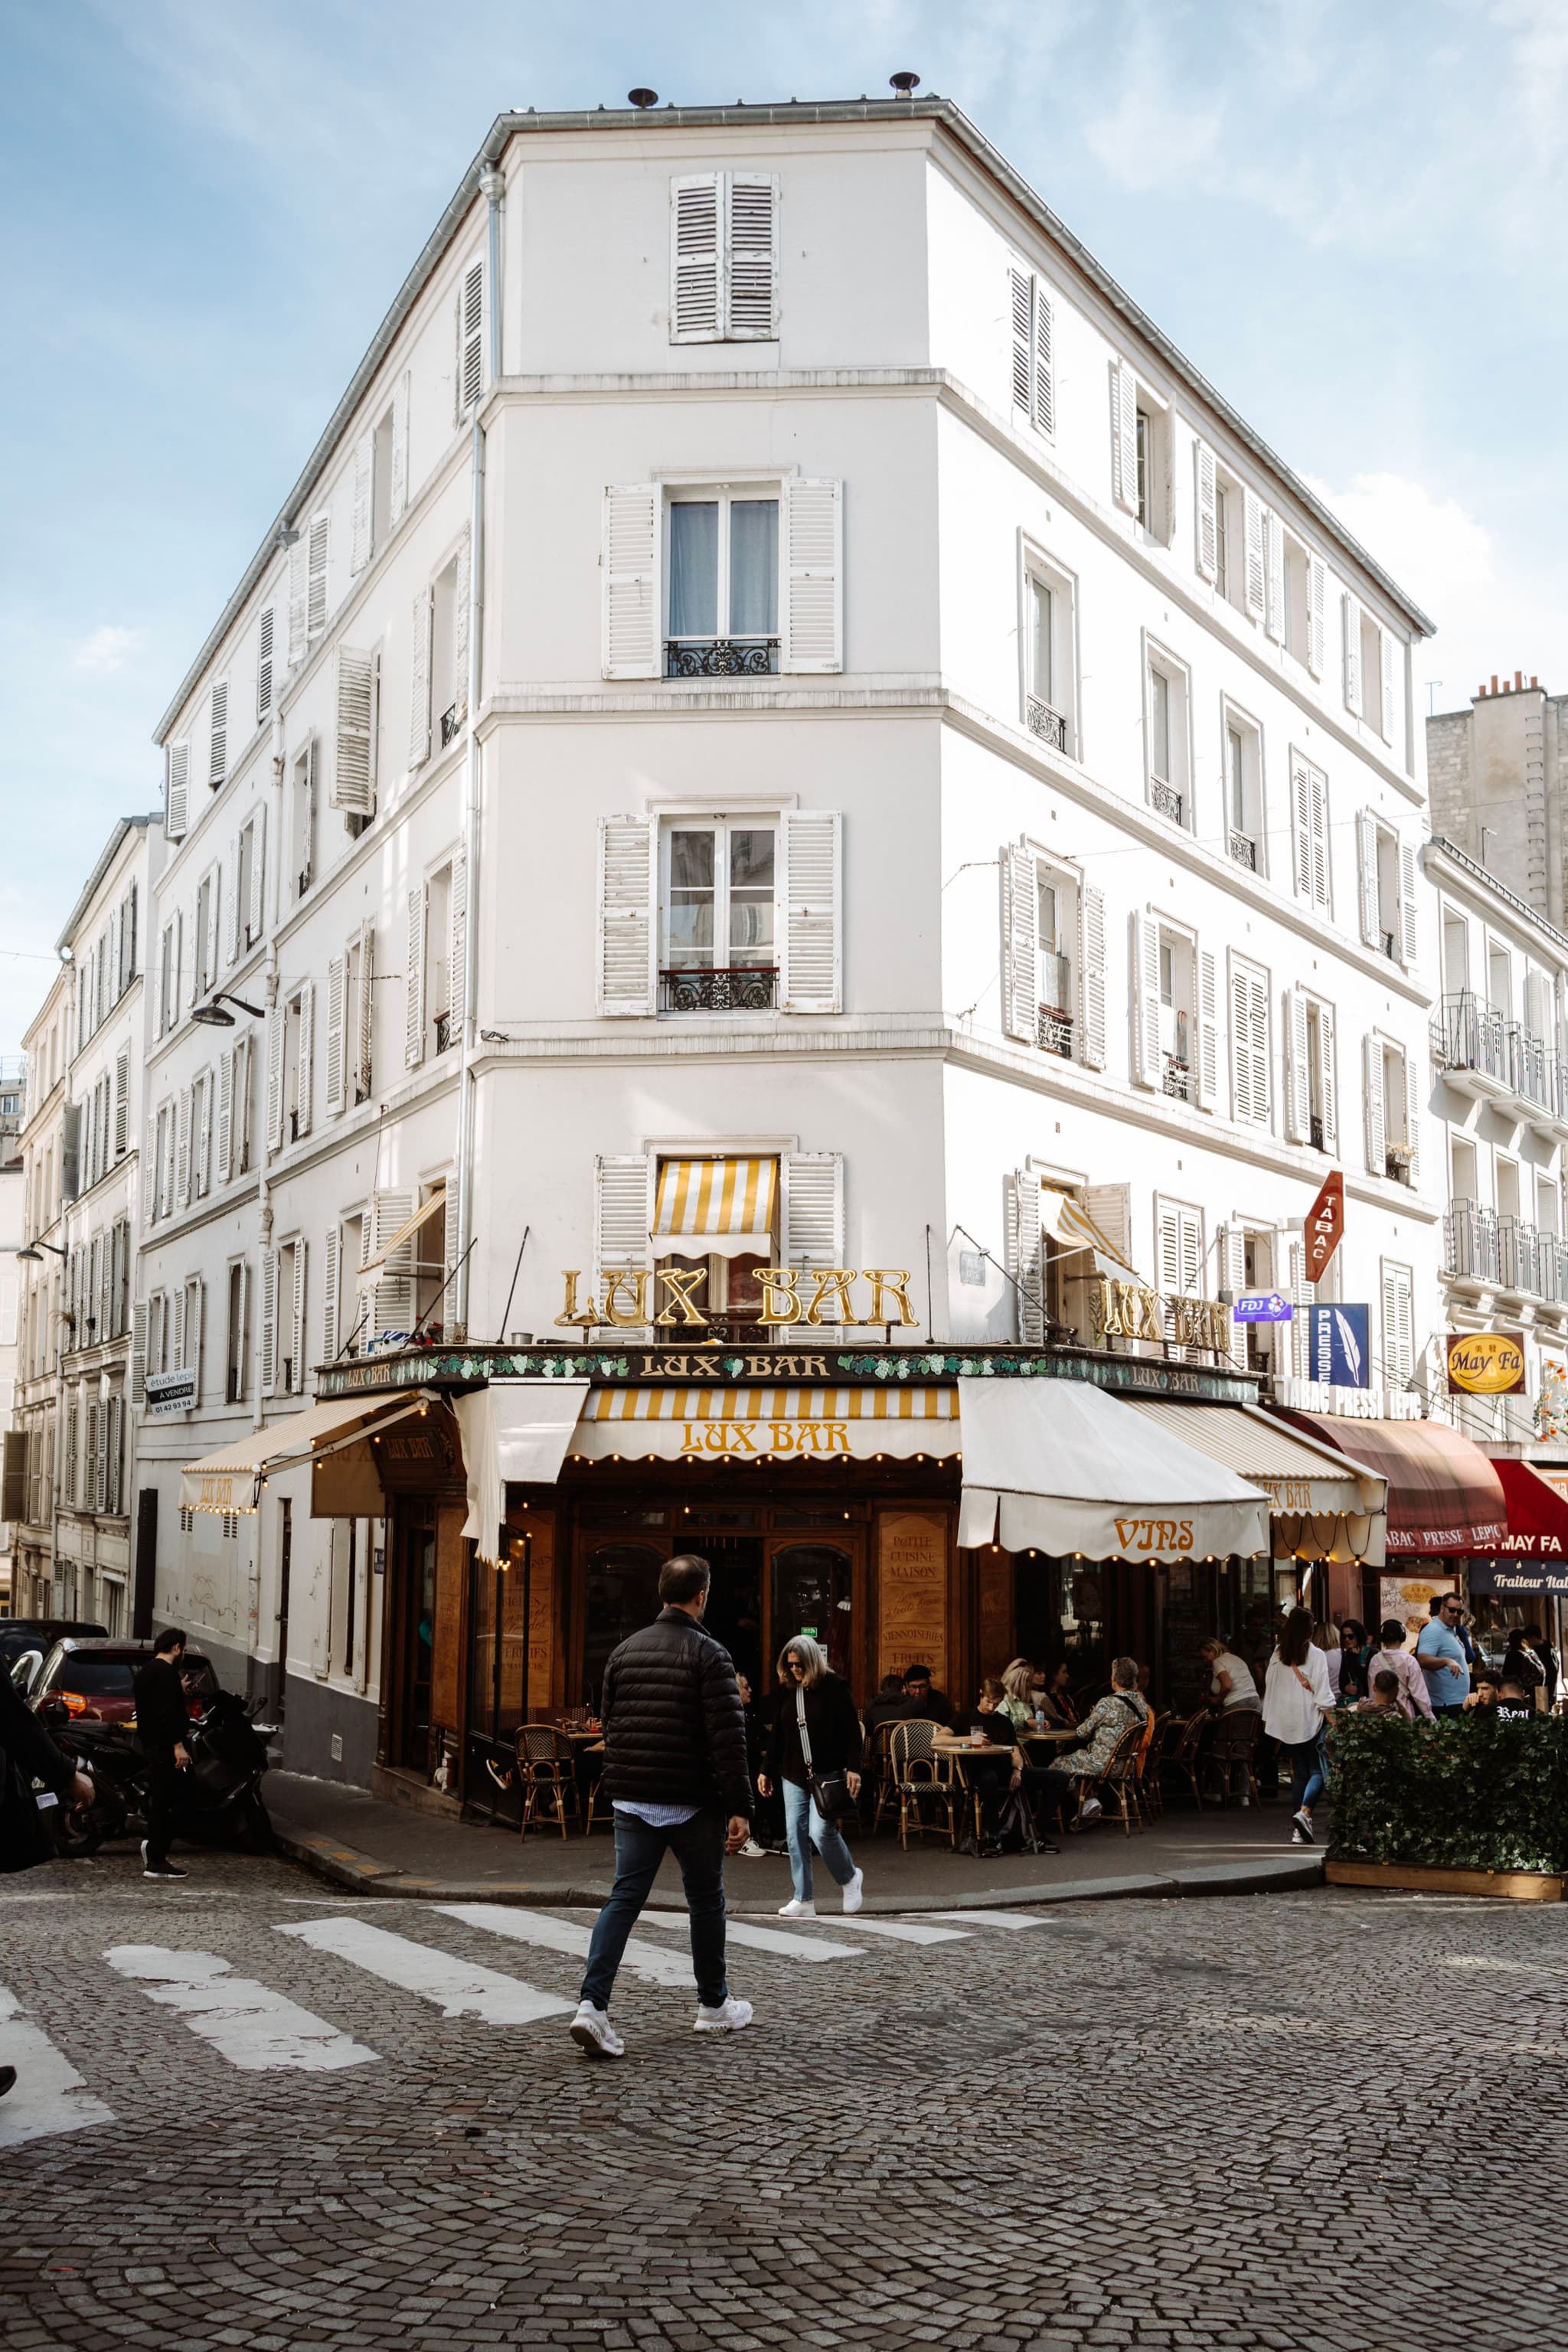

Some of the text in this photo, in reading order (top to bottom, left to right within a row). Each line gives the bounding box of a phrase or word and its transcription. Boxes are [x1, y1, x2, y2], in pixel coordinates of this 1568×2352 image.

[1312, 1196, 1336, 1259] TABAC
[554, 1268, 919, 1327] LUX BAR
[1240, 1300, 1263, 1311] FDJ
[1098, 1279, 1232, 1352] LUX BAR
[1318, 1310, 1331, 1384] PRESSE
[348, 1364, 390, 1387] LUX BAR
[640, 1356, 831, 1377] LUX BAR
[1452, 1351, 1521, 1380] May Fa
[165, 1385, 193, 1397] VENDRE
[1132, 1367, 1200, 1393] LUX BAR
[1282, 1378, 1330, 1414] TABAC
[1390, 1391, 1422, 1420] LEPIC
[386, 1438, 409, 1459] LUX
[407, 1437, 434, 1459] BAR
[680, 1423, 852, 1452] LUX BAR
[1256, 1481, 1312, 1509] UX BAR
[1113, 1518, 1194, 1550] VINS
[1385, 1530, 1416, 1547] ABAC
[1423, 1528, 1465, 1547] PRESSE
[1471, 1524, 1501, 1541] LEPIC
[1501, 1534, 1536, 1551] MAY
[1540, 1536, 1562, 1552] FA
[890, 1551, 936, 1563] CUISINE
[890, 1566, 937, 1578] MAISON
[1494, 1574, 1544, 1589] Traiteur
[882, 1628, 944, 1642] VIENNOISERIES
[893, 1652, 936, 1664] FRUITS
[1496, 1706, 1530, 1720] Real
